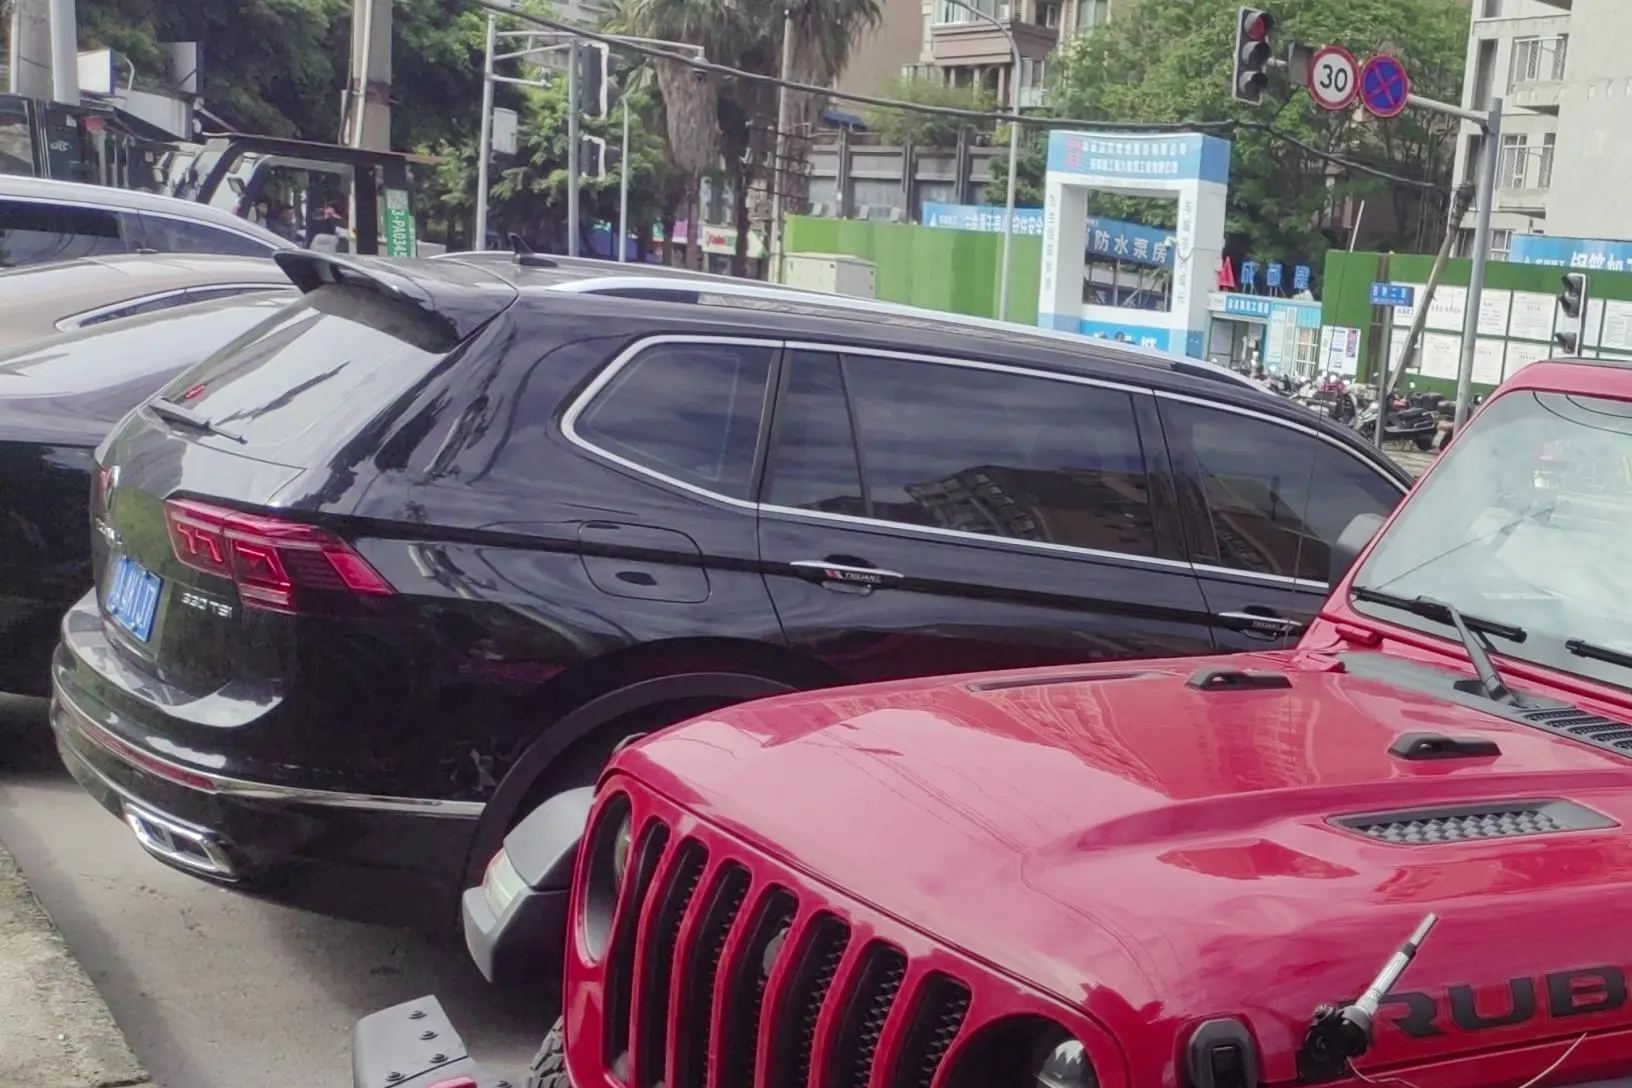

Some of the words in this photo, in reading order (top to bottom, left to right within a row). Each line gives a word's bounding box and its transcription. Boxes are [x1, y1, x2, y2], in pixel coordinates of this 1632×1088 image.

[1320, 64, 1348, 92] 30
[1086, 227, 1168, 263] 防水泵房
